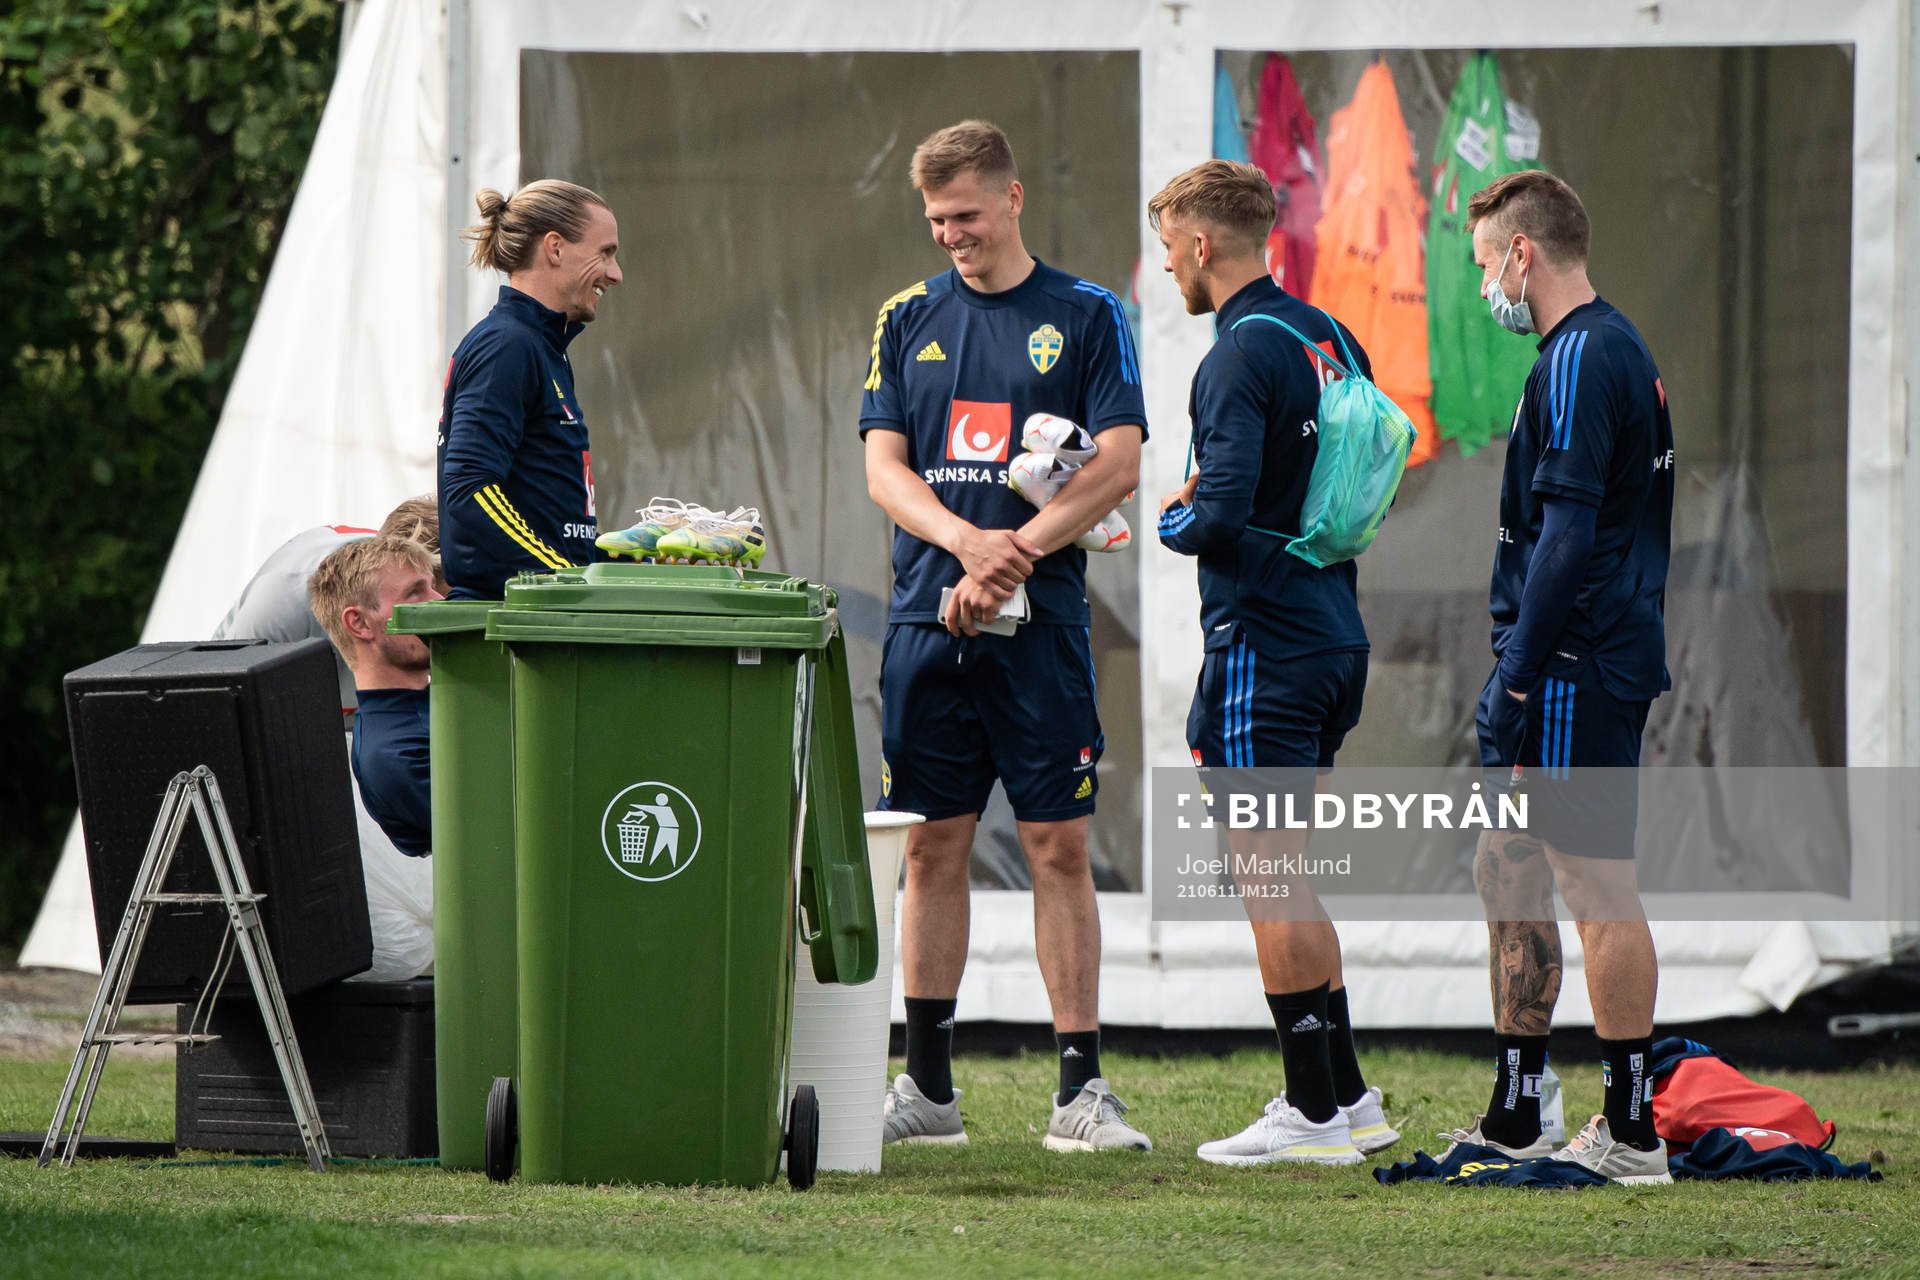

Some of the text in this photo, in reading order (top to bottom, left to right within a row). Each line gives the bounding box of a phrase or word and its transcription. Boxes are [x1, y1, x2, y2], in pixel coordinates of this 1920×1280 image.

[916, 353, 947, 361] adidas
[924, 467, 993, 484] SVENSKA
[1629, 1071, 1643, 1120] TAPEDESIGN
